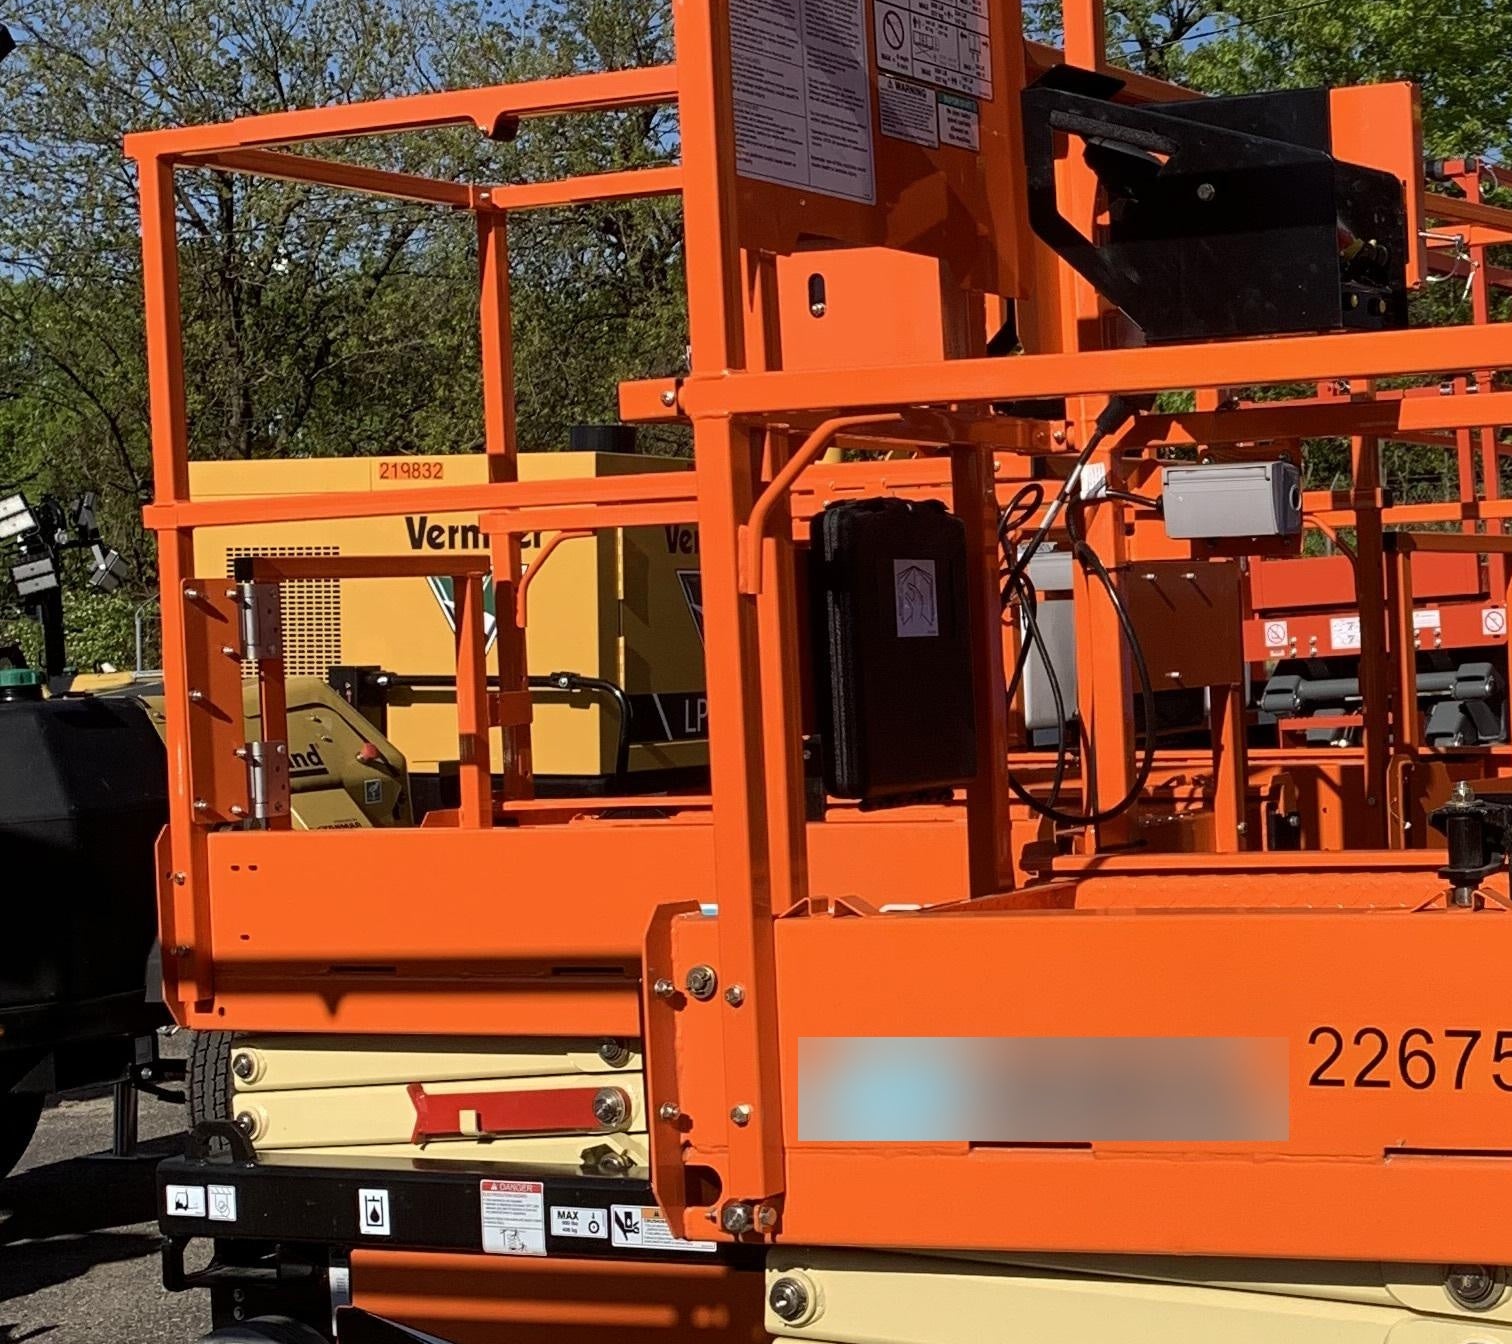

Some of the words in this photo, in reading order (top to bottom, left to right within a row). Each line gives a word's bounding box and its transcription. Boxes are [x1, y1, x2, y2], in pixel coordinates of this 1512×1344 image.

[380, 462, 443, 480] 219832
[405, 516, 541, 550] Vermer
[500, 1183, 534, 1192] DANGER
[557, 1210, 579, 1220] MAX
